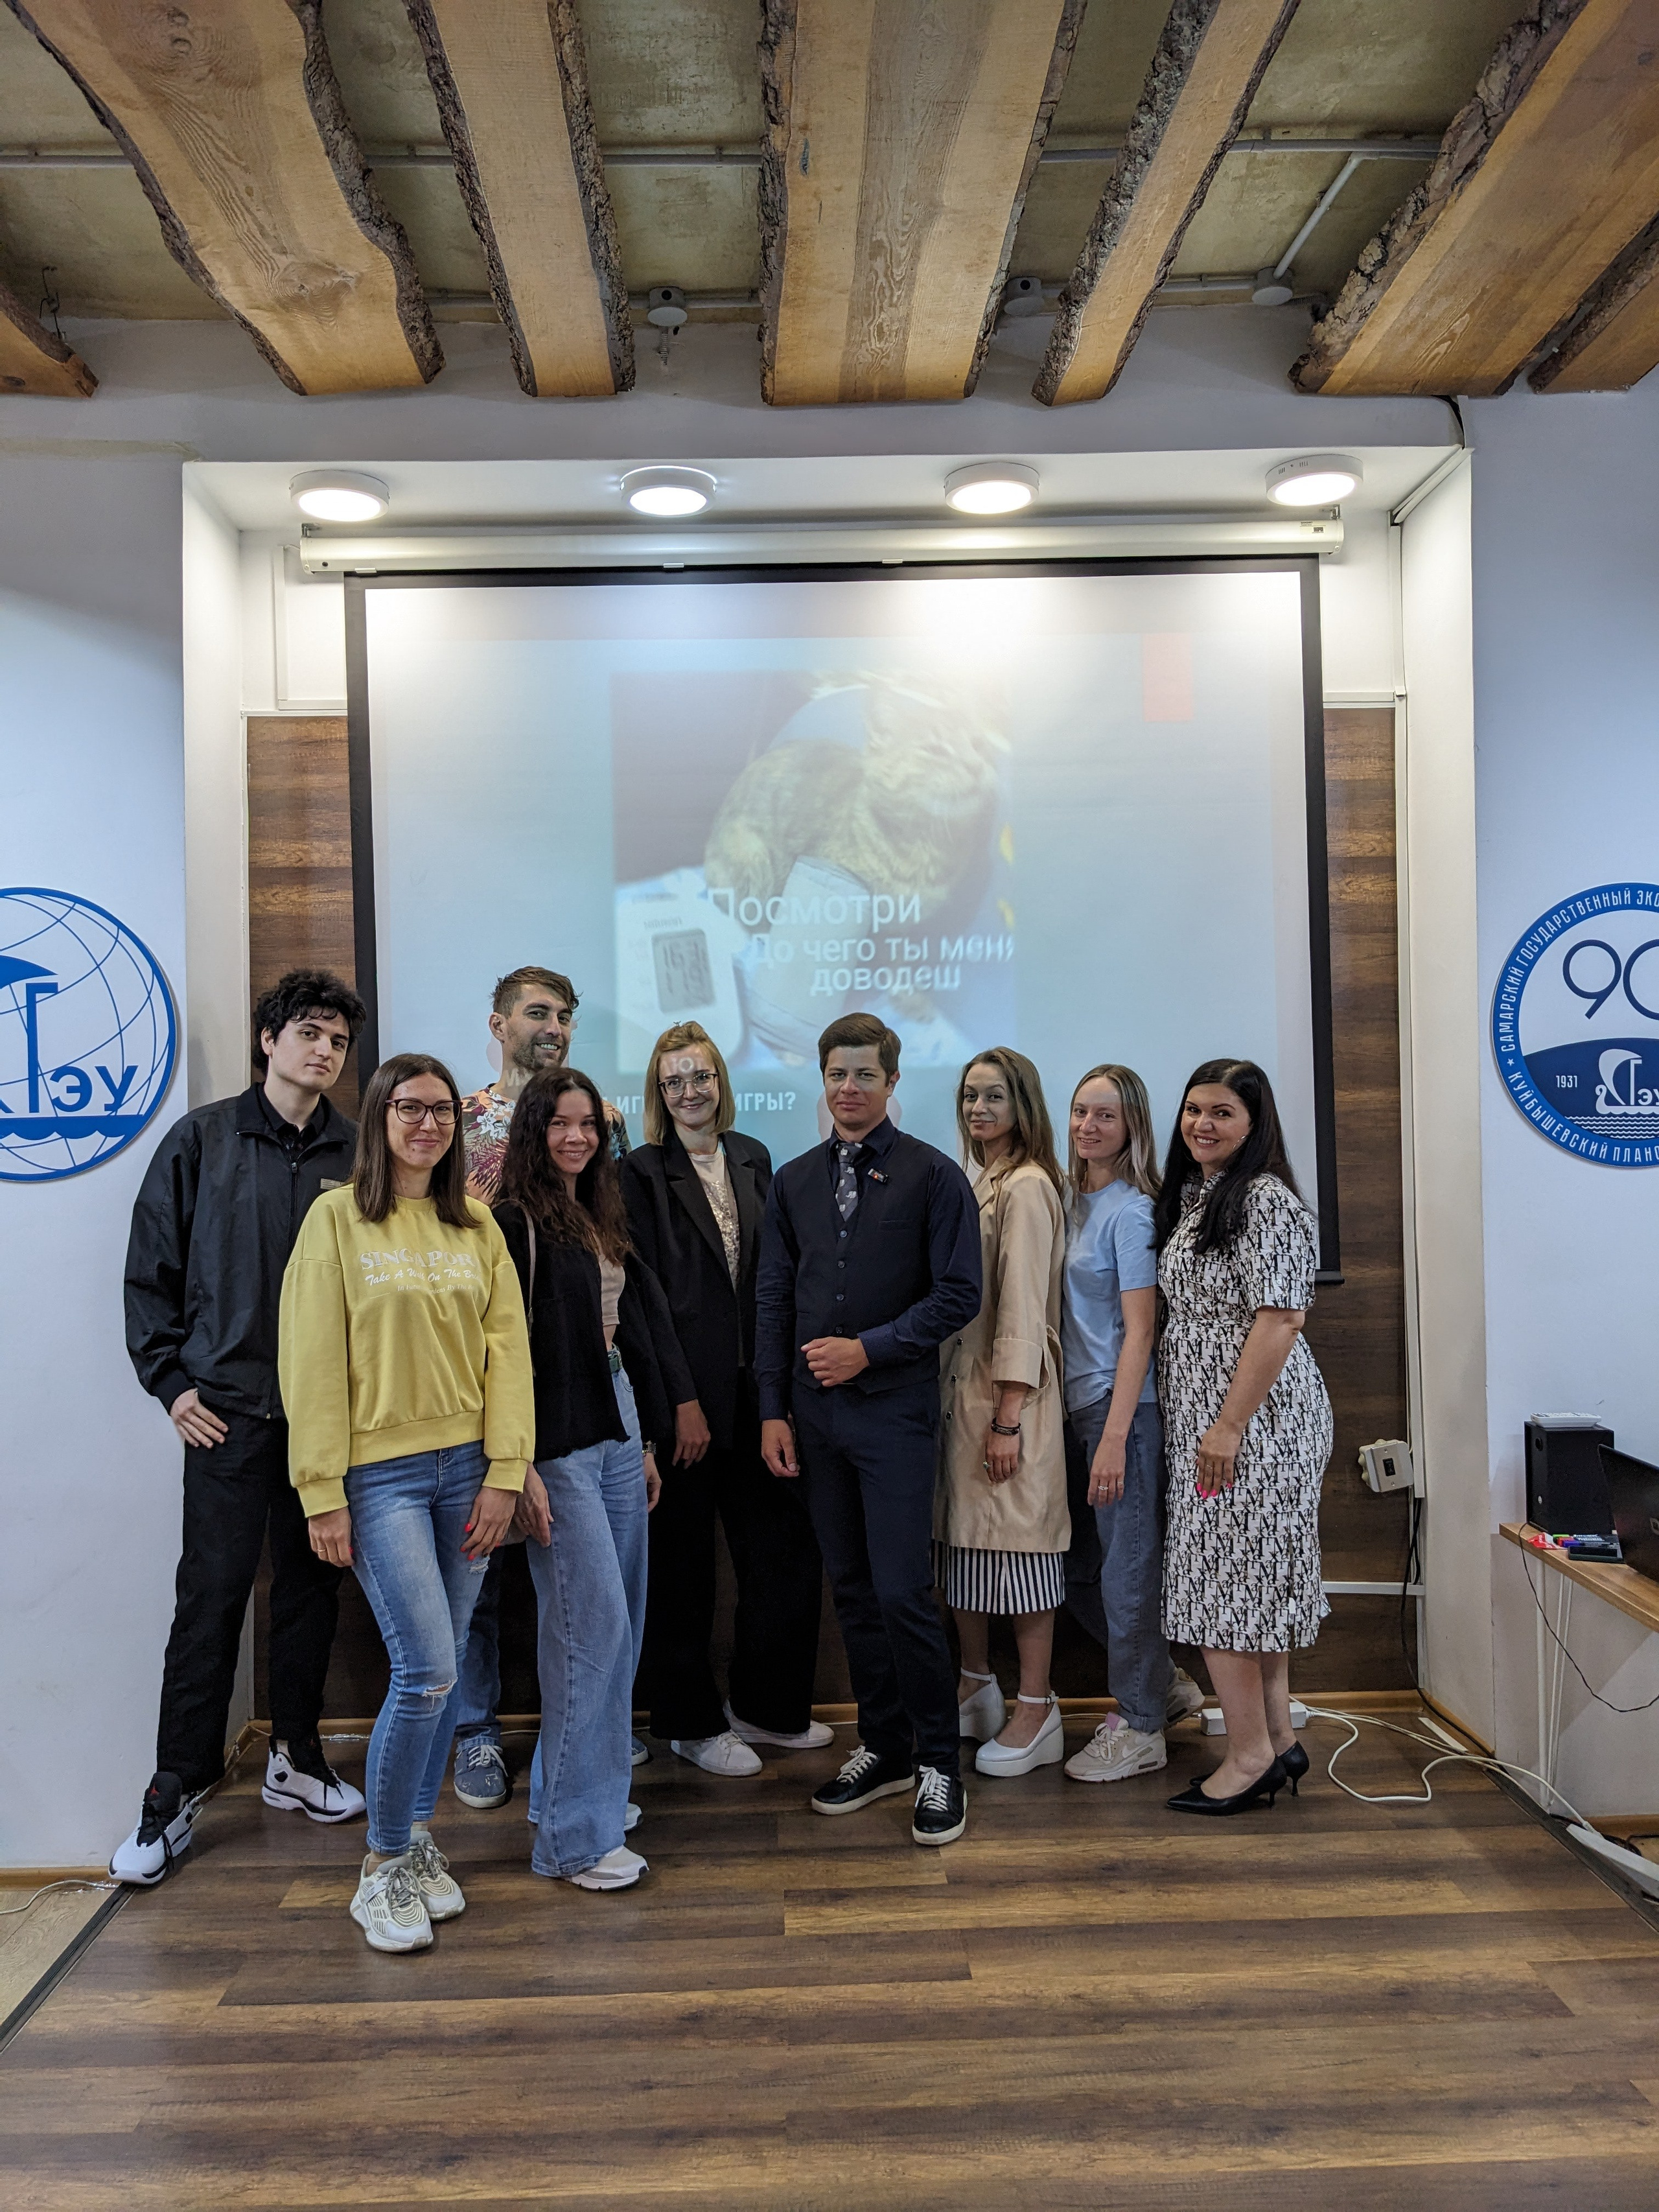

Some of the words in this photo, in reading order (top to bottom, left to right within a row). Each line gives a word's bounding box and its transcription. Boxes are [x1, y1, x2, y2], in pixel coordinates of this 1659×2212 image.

[708, 887, 921, 933] Посмотри
[804, 937, 876, 962] чего
[885, 937, 929, 962] ты
[809, 965, 962, 997] доводеш
[1499, 966, 1525, 1052] САМАРСКИЙ
[1515, 887, 1630, 967] ГОСУДАРСТВЕННЫЙ
[1555, 1075, 1578, 1088] 1931
[1508, 1071, 1608, 1159] КУЙБЫШЕВСКИЙ
[360, 1248, 480, 1270] SINGAPOR
[365, 1272, 391, 1286] Take
[394, 1269, 404, 1280] A
[428, 1272, 441, 1282] On
[443, 1268, 461, 1279] The
